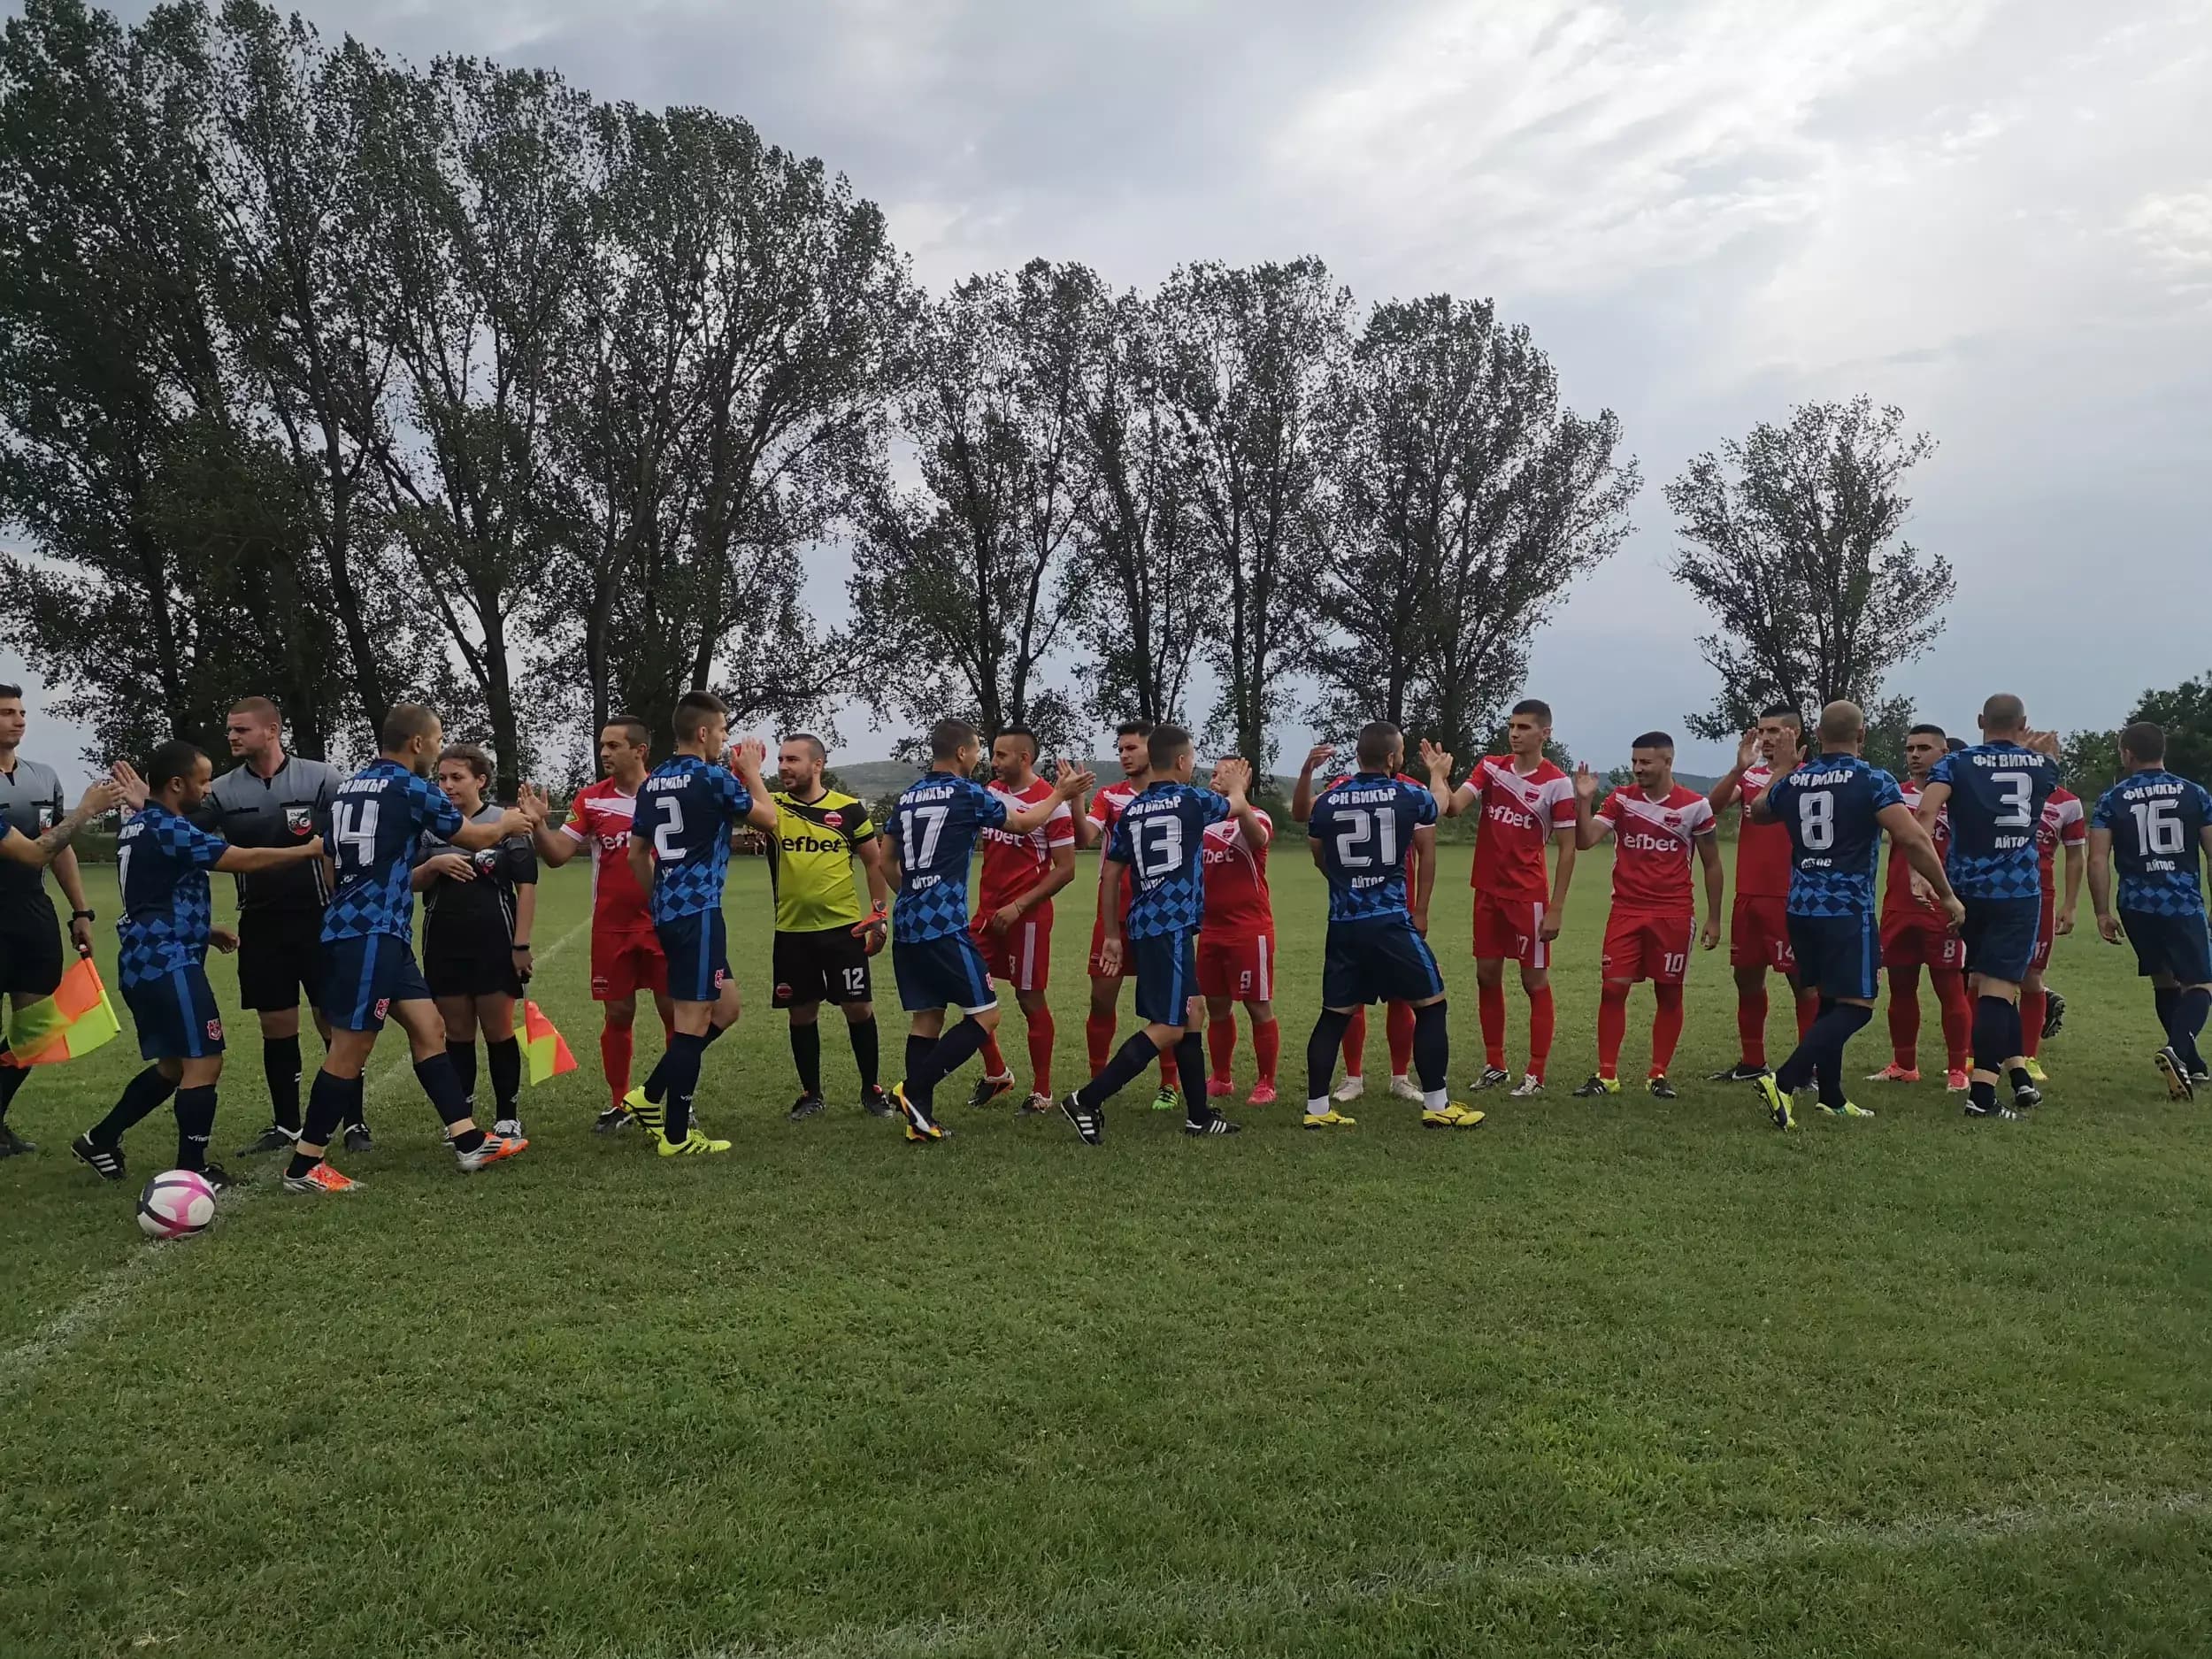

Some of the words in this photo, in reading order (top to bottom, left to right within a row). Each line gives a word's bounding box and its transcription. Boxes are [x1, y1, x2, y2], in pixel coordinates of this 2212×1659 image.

[1999, 754, 2045, 767] ВИХЪР
[1790, 773, 1809, 787] ФК
[915, 787, 955, 803] ВИХЪР
[1351, 787, 1396, 804] ВИХЪР
[1991, 772, 2033, 827] 3
[2123, 787, 2146, 801] ФК
[2145, 784, 2184, 797] ВИХЪР
[1486, 804, 1533, 830] efbet
[1799, 790, 1834, 850] 8
[2130, 799, 2185, 856] 16
[331, 799, 380, 869] 14
[654, 796, 687, 861] 2
[900, 805, 949, 871] 17
[1332, 807, 1396, 868] 21
[781, 834, 842, 853] efbet
[1128, 814, 1182, 879] 13
[1624, 832, 1679, 853] efbet
[2146, 859, 2176, 872] АЙТОС
[1943, 939, 1956, 958] 8
[1664, 952, 1685, 972] 10
[842, 967, 864, 990] 12
[1240, 970, 1252, 991] 9
